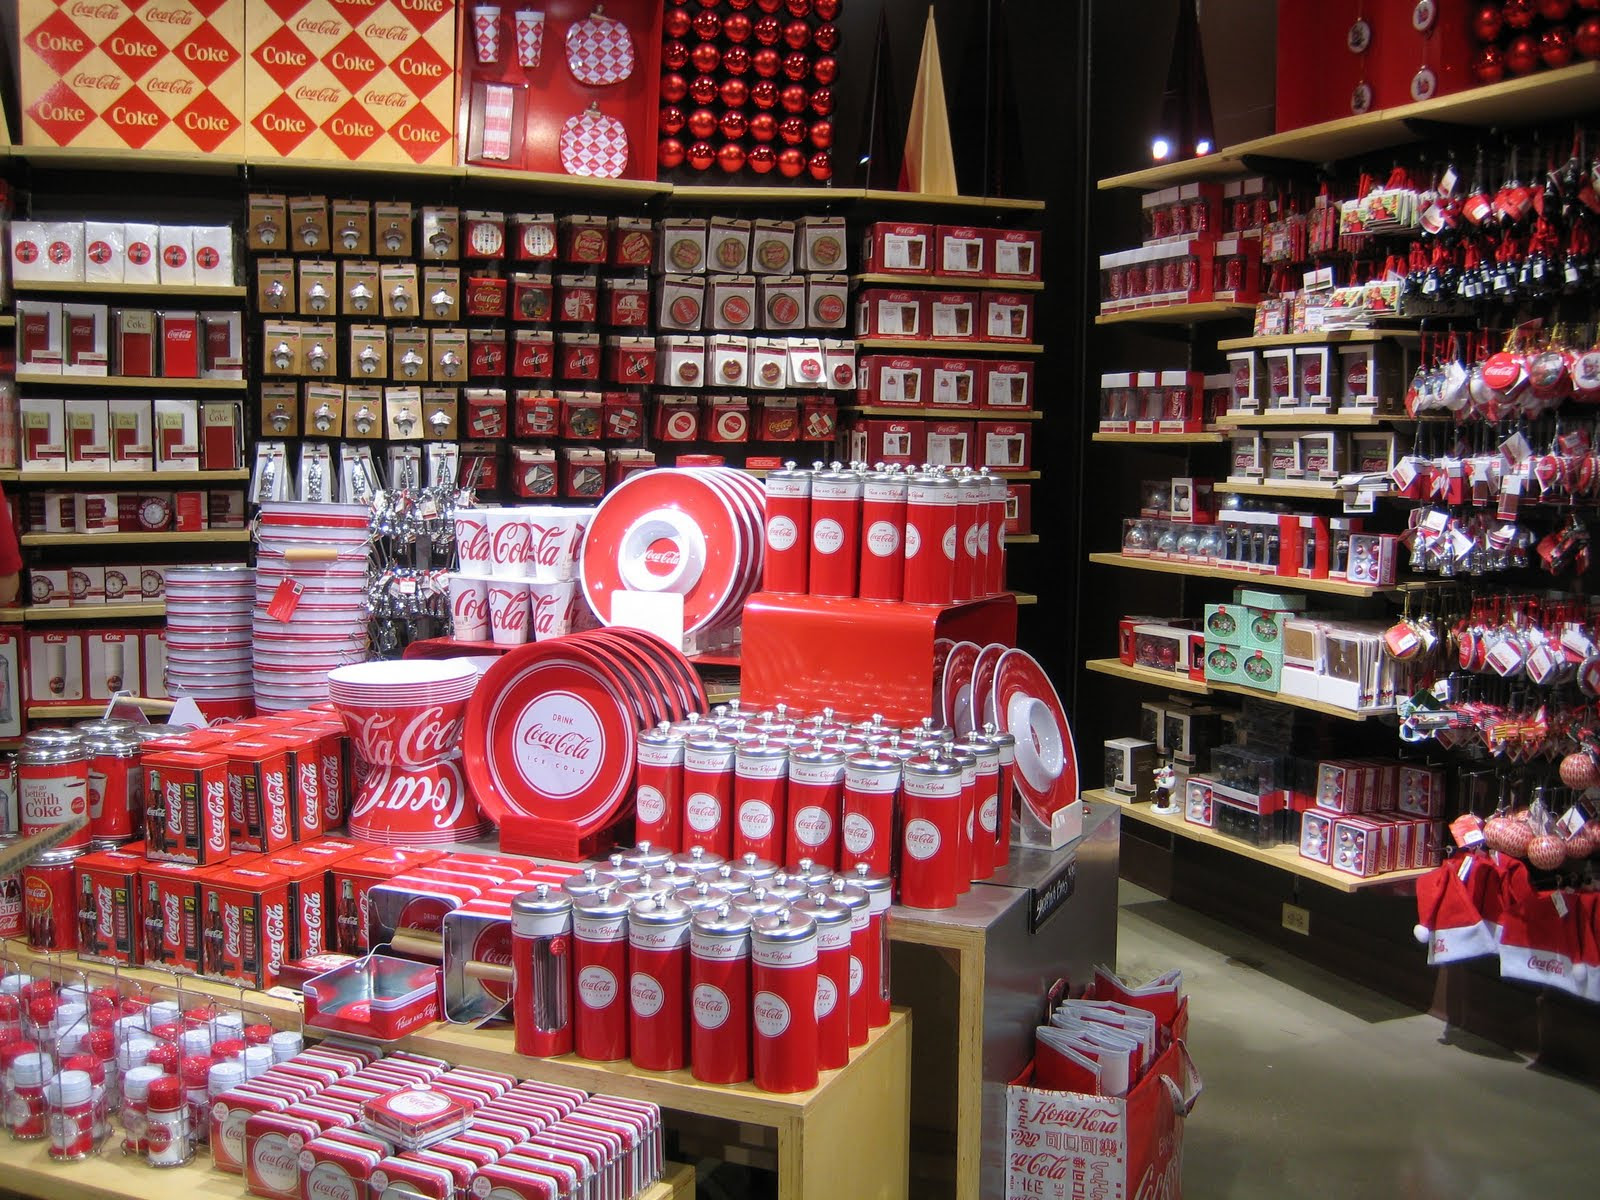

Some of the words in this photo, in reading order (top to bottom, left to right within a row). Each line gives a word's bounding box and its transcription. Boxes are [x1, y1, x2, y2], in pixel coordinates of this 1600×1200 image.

[36, 32, 84, 52] Coke
[111, 37, 158, 57] Coke
[184, 43, 229, 62] Coke
[263, 47, 306, 66] Coke
[332, 52, 375, 72] Coke
[400, 57, 442, 77] Coke
[38, 102, 85, 122] Coke
[112, 106, 159, 126] Coke
[184, 111, 229, 131] Coke
[263, 114, 306, 133] Coke
[332, 119, 374, 137] Coke
[399, 124, 440, 143] Coke
[552, 713, 574, 725] DRINK
[524, 723, 595, 760] Coca-Cola
[25, 789, 47, 797] better
[301, 763, 318, 829] Coca-Cola
[322, 756, 339, 820] Coca-Cola
[33, 793, 59, 805] with
[167, 780, 182, 834] Coca-Cola
[266, 771, 287, 839] Coca-Cola
[26, 802, 63, 818] Coke
[207, 781, 225, 851] Coca-Cola
[1, 904, 19, 914] SIZE
[98, 884, 113, 937] Coca-Cola
[165, 891, 180, 945] Coca-Cola
[225, 902, 239, 957] Coca-Cola
[1527, 955, 1564, 975] Coca-Cola
